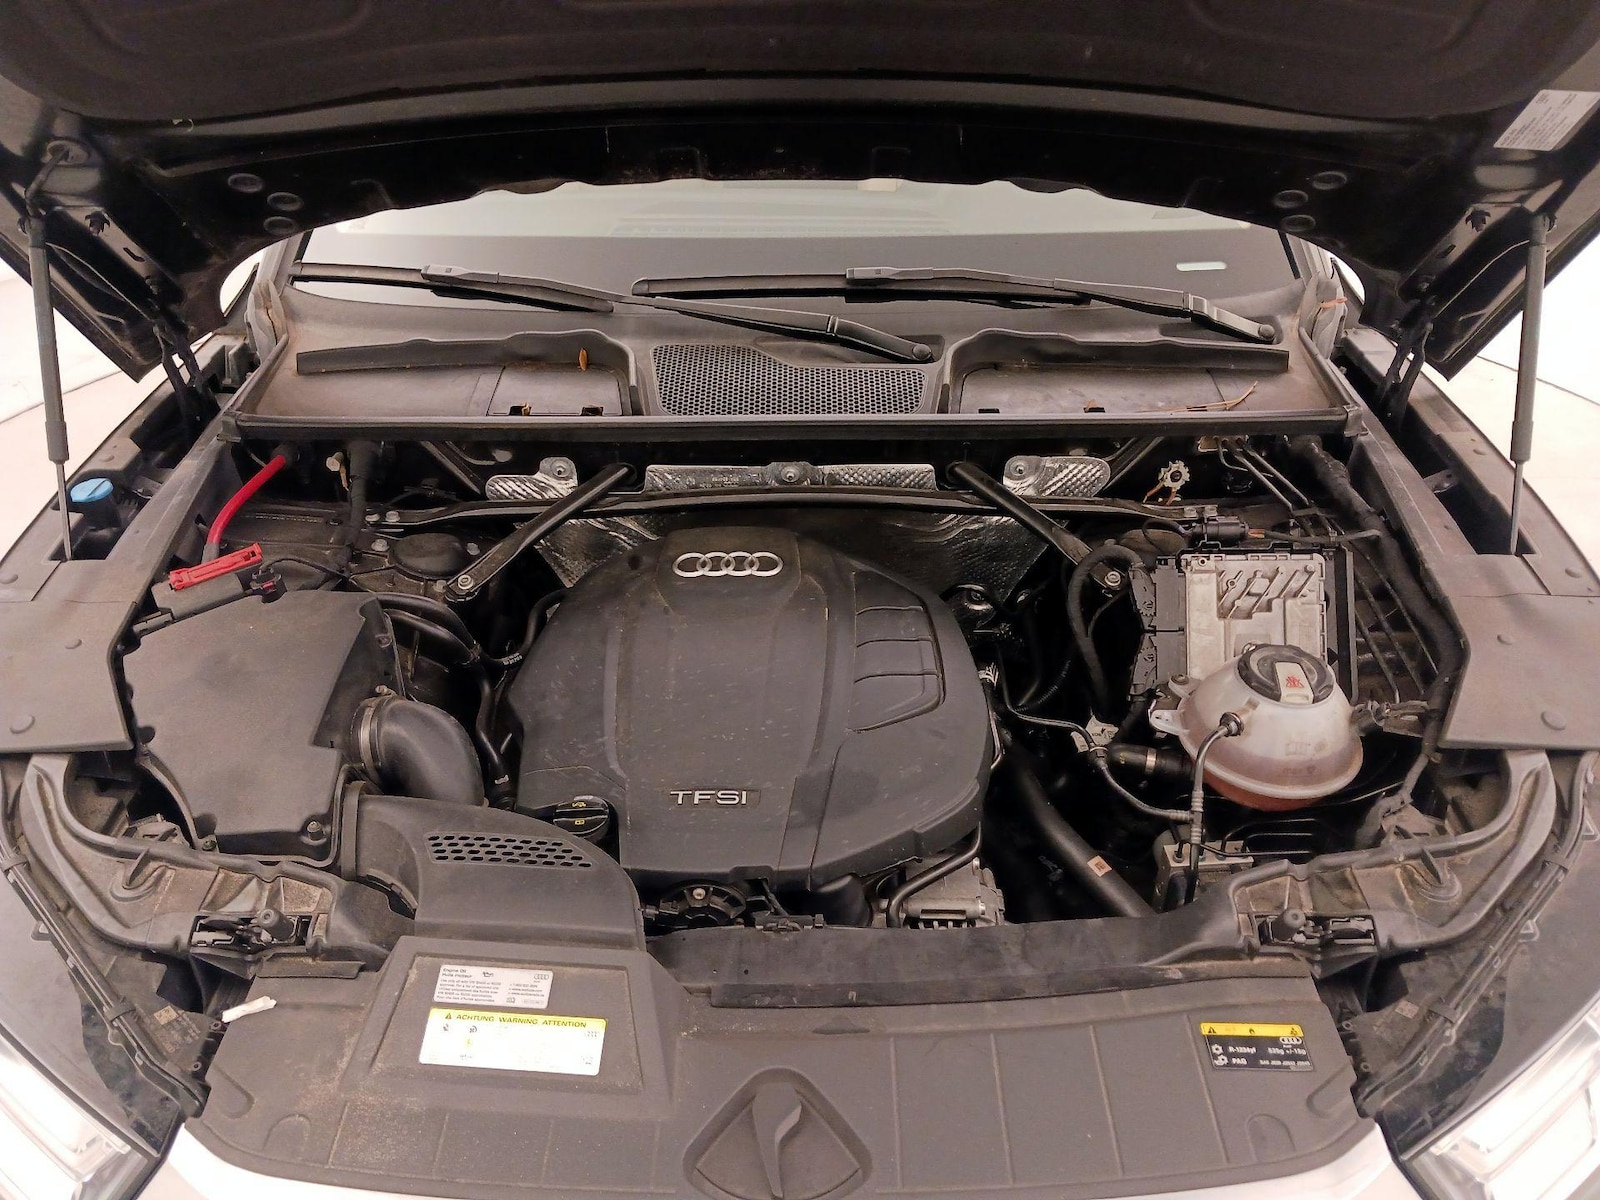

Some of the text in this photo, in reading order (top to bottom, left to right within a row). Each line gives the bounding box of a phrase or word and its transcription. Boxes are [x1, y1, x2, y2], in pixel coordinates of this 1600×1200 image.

[669, 790, 747, 805] TFSI
[456, 1014, 587, 1028] ACHTUNG WARNING ATTENTION
